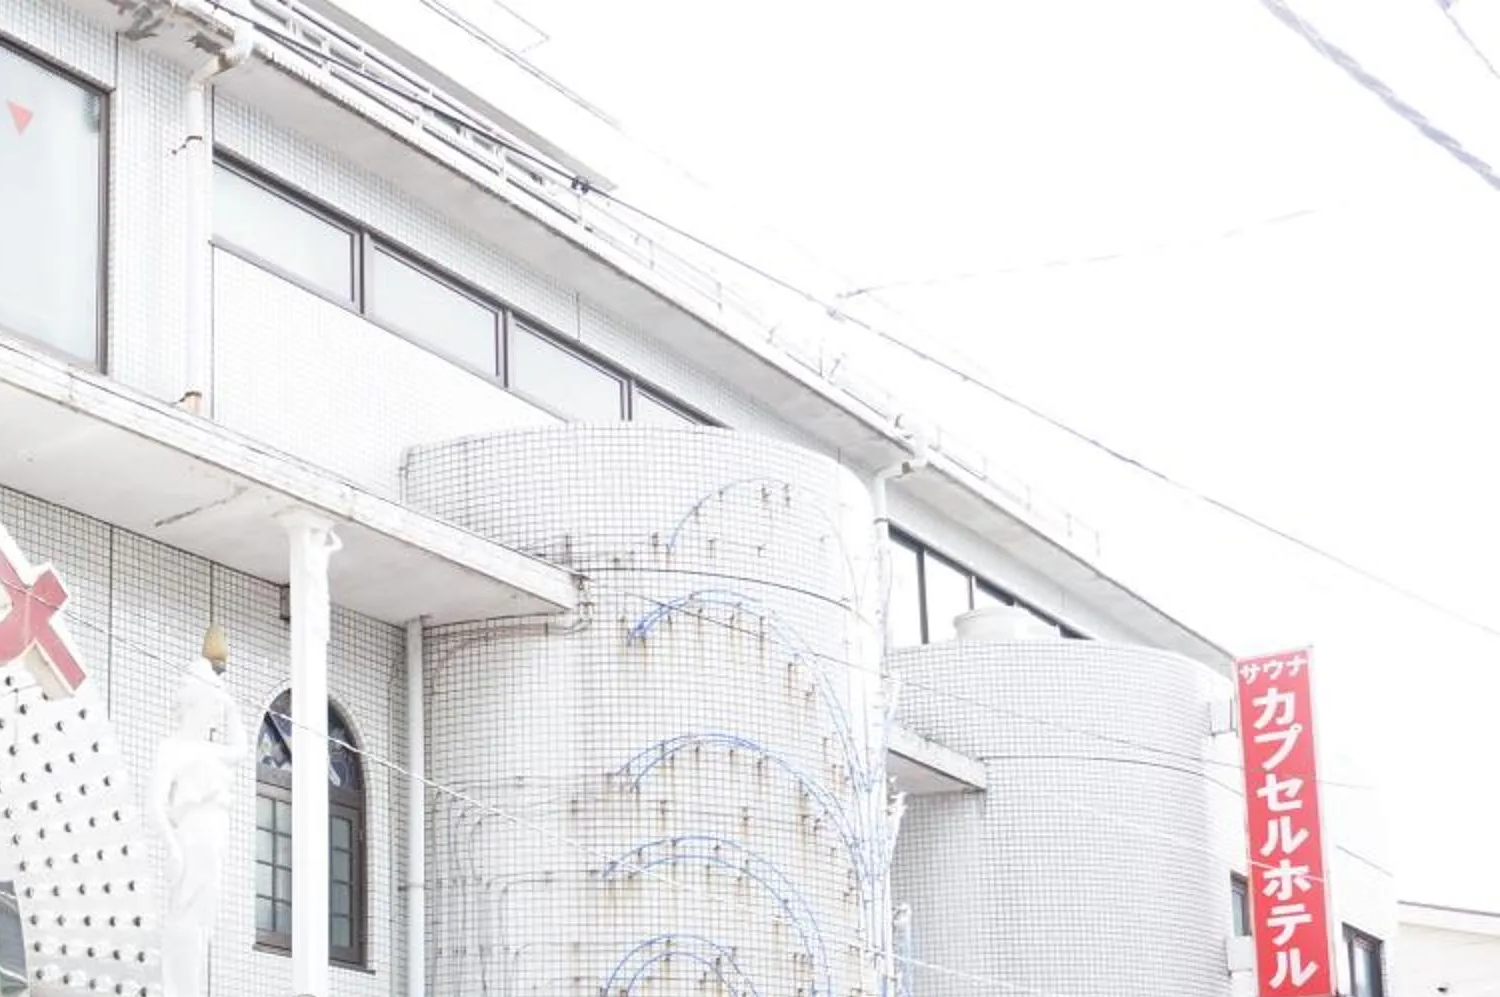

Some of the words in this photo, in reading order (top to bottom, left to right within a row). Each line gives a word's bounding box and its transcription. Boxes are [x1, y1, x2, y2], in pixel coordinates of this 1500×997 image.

[1239, 656, 1308, 684] サウナ
[1252, 687, 1320, 989] カプセルホテル
